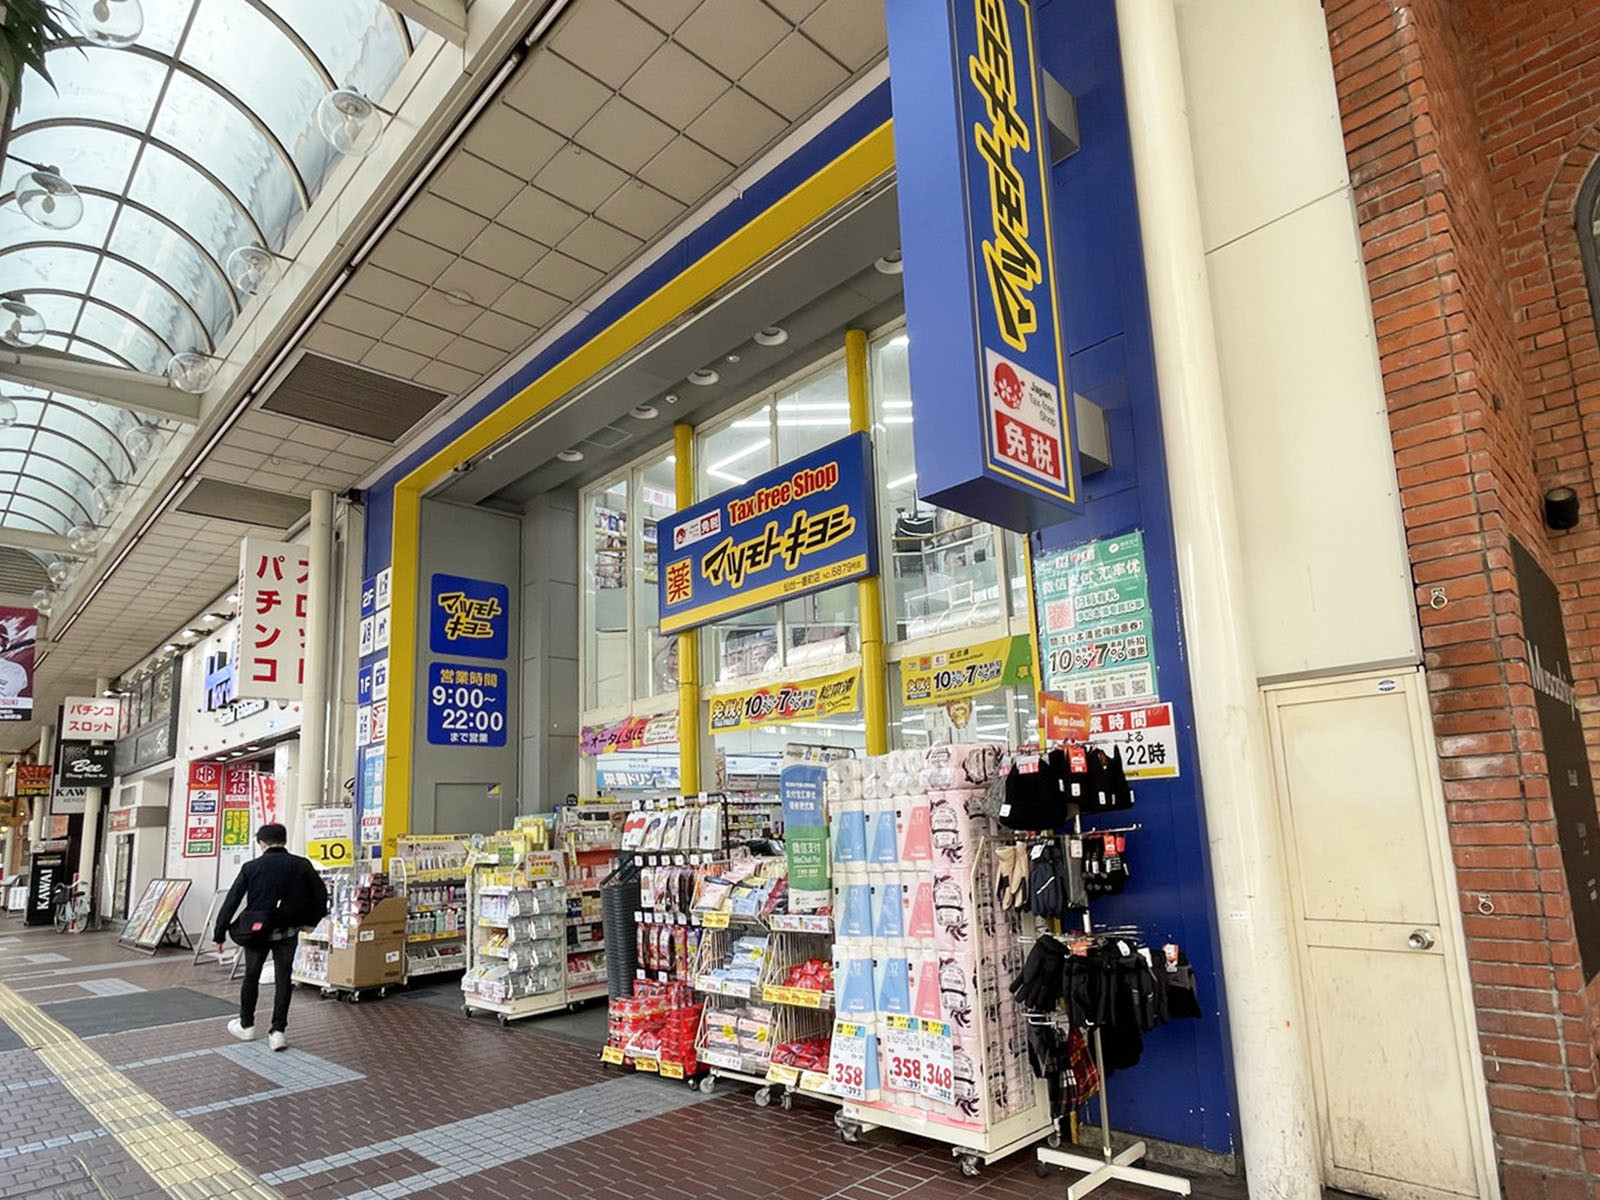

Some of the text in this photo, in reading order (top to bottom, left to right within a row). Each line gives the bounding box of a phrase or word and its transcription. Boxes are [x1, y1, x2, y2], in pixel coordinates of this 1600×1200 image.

[1004, 421, 1054, 474] 免税
[729, 463, 837, 525] Tax Free Shop
[703, 507, 853, 586] マツモトキヨシ
[667, 562, 691, 603] 薬
[362, 588, 375, 607] 2F
[438, 592, 502, 619] マツモト
[252, 555, 286, 683] パチンコ
[444, 613, 494, 640] キヨシ
[360, 676, 371, 694] 1F
[440, 669, 498, 688] 営業時間
[70, 704, 114, 716] パチンコ
[442, 708, 503, 731] 22:00
[68, 721, 112, 732] スロット
[450, 732, 488, 744] まで営業
[1125, 731, 1144, 743] よる
[70, 759, 105, 773] Bee
[1125, 743, 1166, 766] 22時
[320, 843, 346, 860] 10
[37, 869, 53, 910] KAWAI
[835, 1063, 863, 1087] 358
[892, 1056, 921, 1080] 358
[926, 1063, 952, 1089] 348
